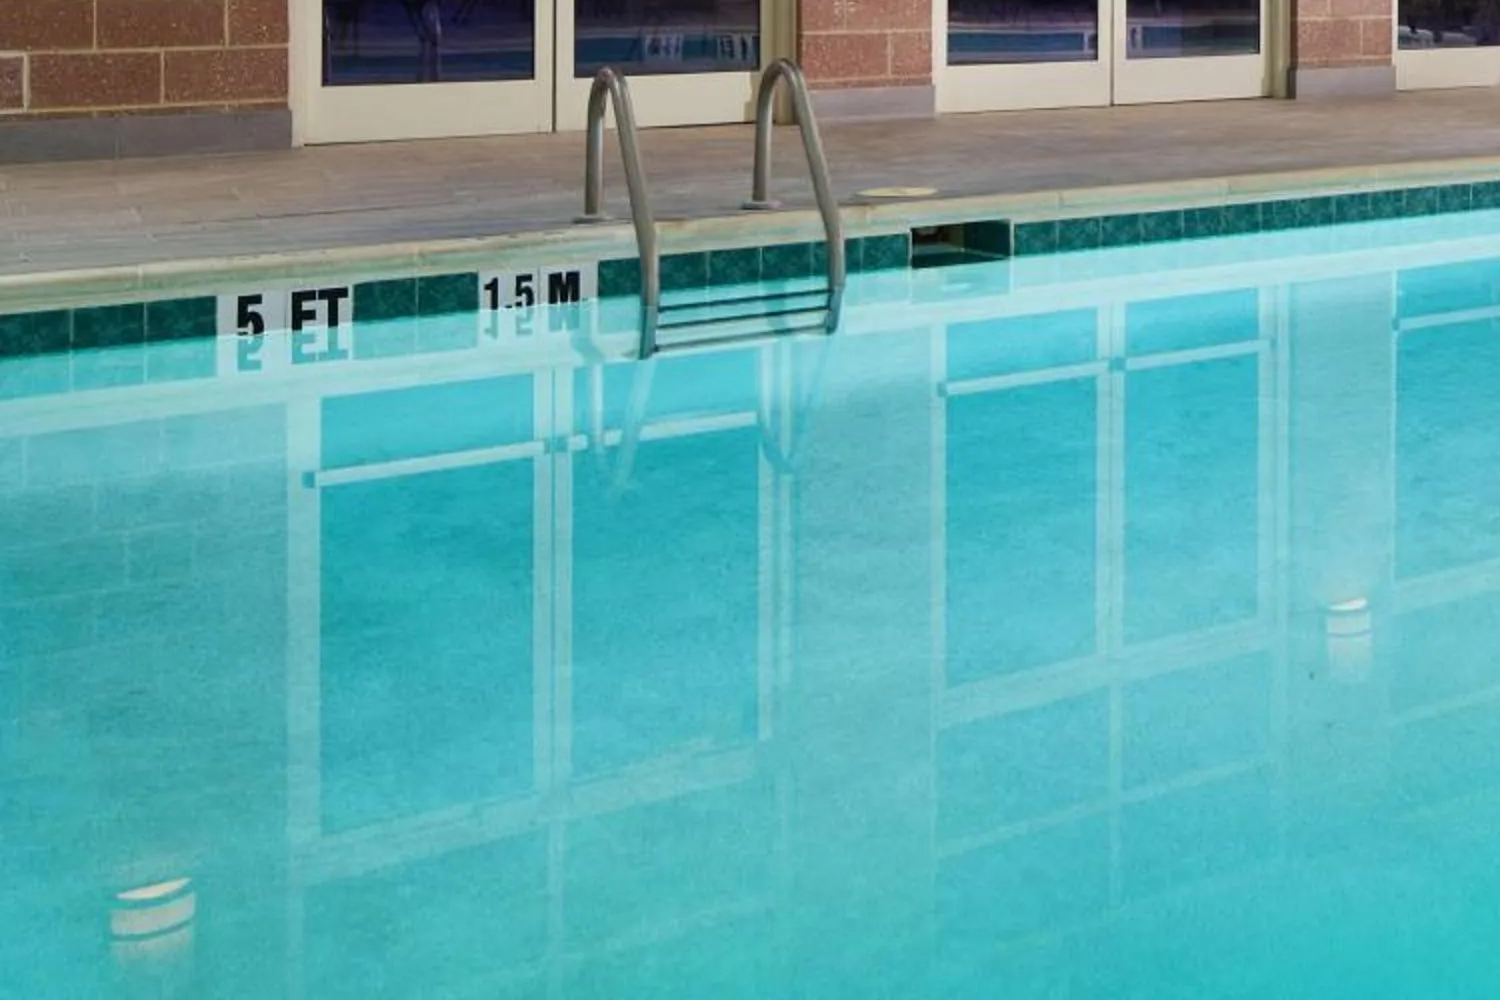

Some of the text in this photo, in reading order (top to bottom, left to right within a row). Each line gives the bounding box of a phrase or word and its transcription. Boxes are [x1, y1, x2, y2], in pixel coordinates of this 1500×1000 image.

[548, 270, 581, 305] M
[237, 286, 349, 337] 5 FT
